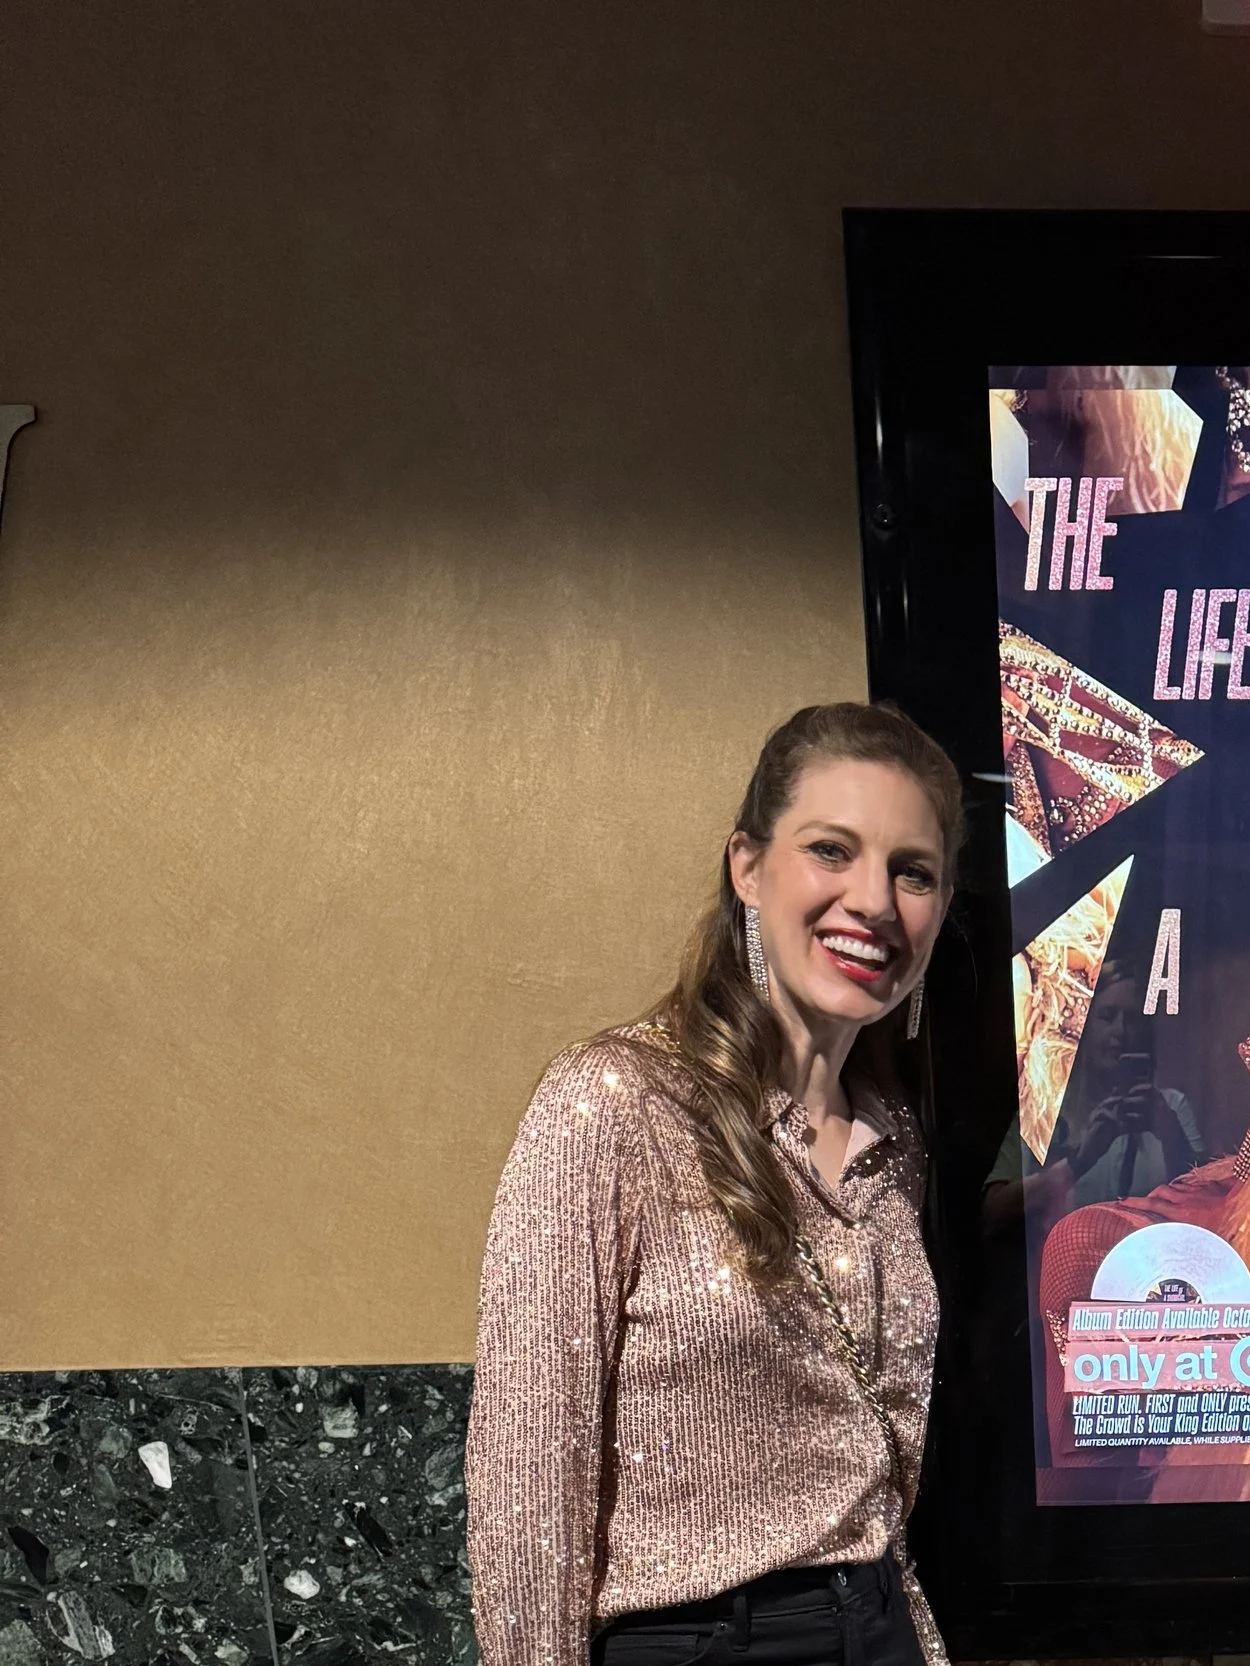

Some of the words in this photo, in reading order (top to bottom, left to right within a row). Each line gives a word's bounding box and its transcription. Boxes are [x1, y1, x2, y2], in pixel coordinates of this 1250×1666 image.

[1024, 477, 1124, 591] THE
[1143, 908, 1181, 1015] A
[1073, 1309, 1112, 1331] Album
[1115, 1308, 1159, 1330] Edition
[1162, 1307, 1219, 1329] Available
[1074, 1345, 1165, 1389] only
[1175, 1345, 1217, 1380] at
[1073, 1395, 1115, 1415] LIMITED
[1117, 1394, 1142, 1414] RUN.
[1145, 1393, 1176, 1413] FIRST
[1177, 1393, 1199, 1413] and
[1201, 1392, 1228, 1412] ONLY
[1074, 1415, 1093, 1435] The
[1096, 1415, 1131, 1435] Crowd
[1133, 1414, 1145, 1434] is
[1148, 1414, 1173, 1433] Your
[1174, 1413, 1200, 1435] King
[1202, 1412, 1241, 1432] Edition
[1075, 1438, 1107, 1447] LIMITED
[1108, 1437, 1149, 1447] QUANTITY
[1193, 1436, 1219, 1445] WHILE
